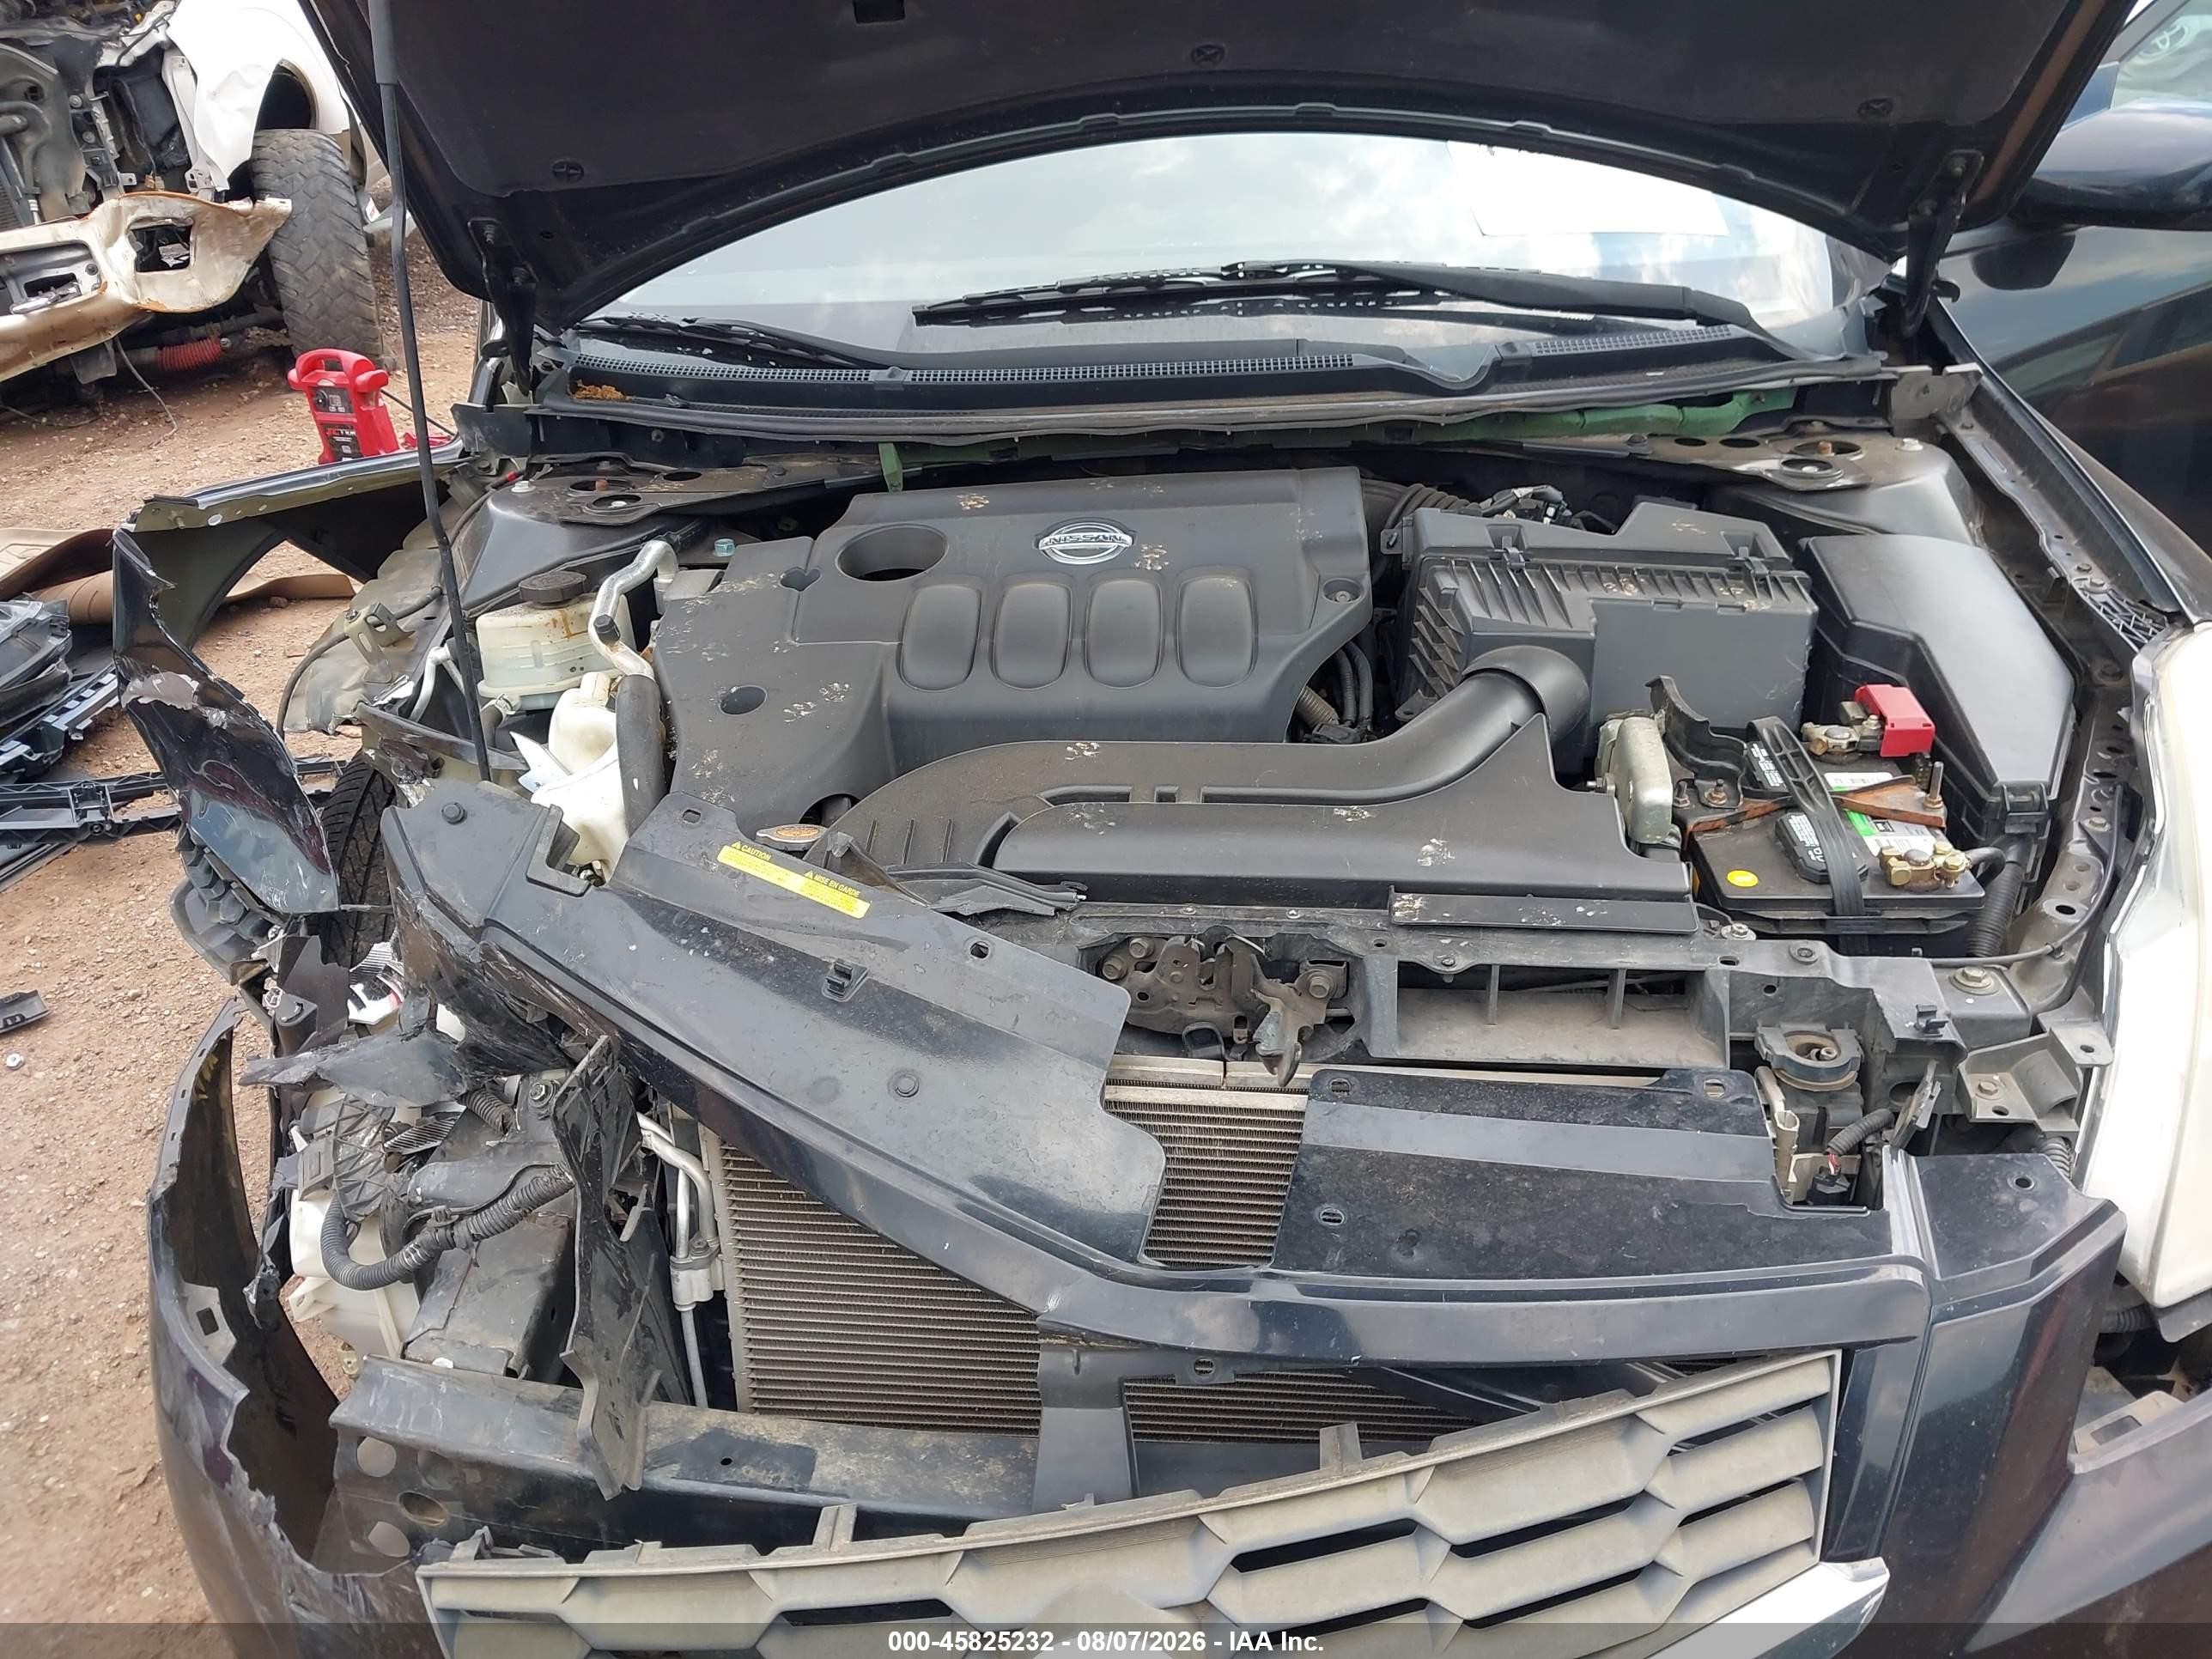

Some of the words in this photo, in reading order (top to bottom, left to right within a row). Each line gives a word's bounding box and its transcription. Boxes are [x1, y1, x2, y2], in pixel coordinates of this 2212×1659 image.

[1047, 534, 1122, 545] NISSAN
[741, 844, 771, 861] CAUTION
[814, 874, 830, 885] MISE
[829, 879, 839, 889] EN
[838, 884, 861, 897] GARDE
